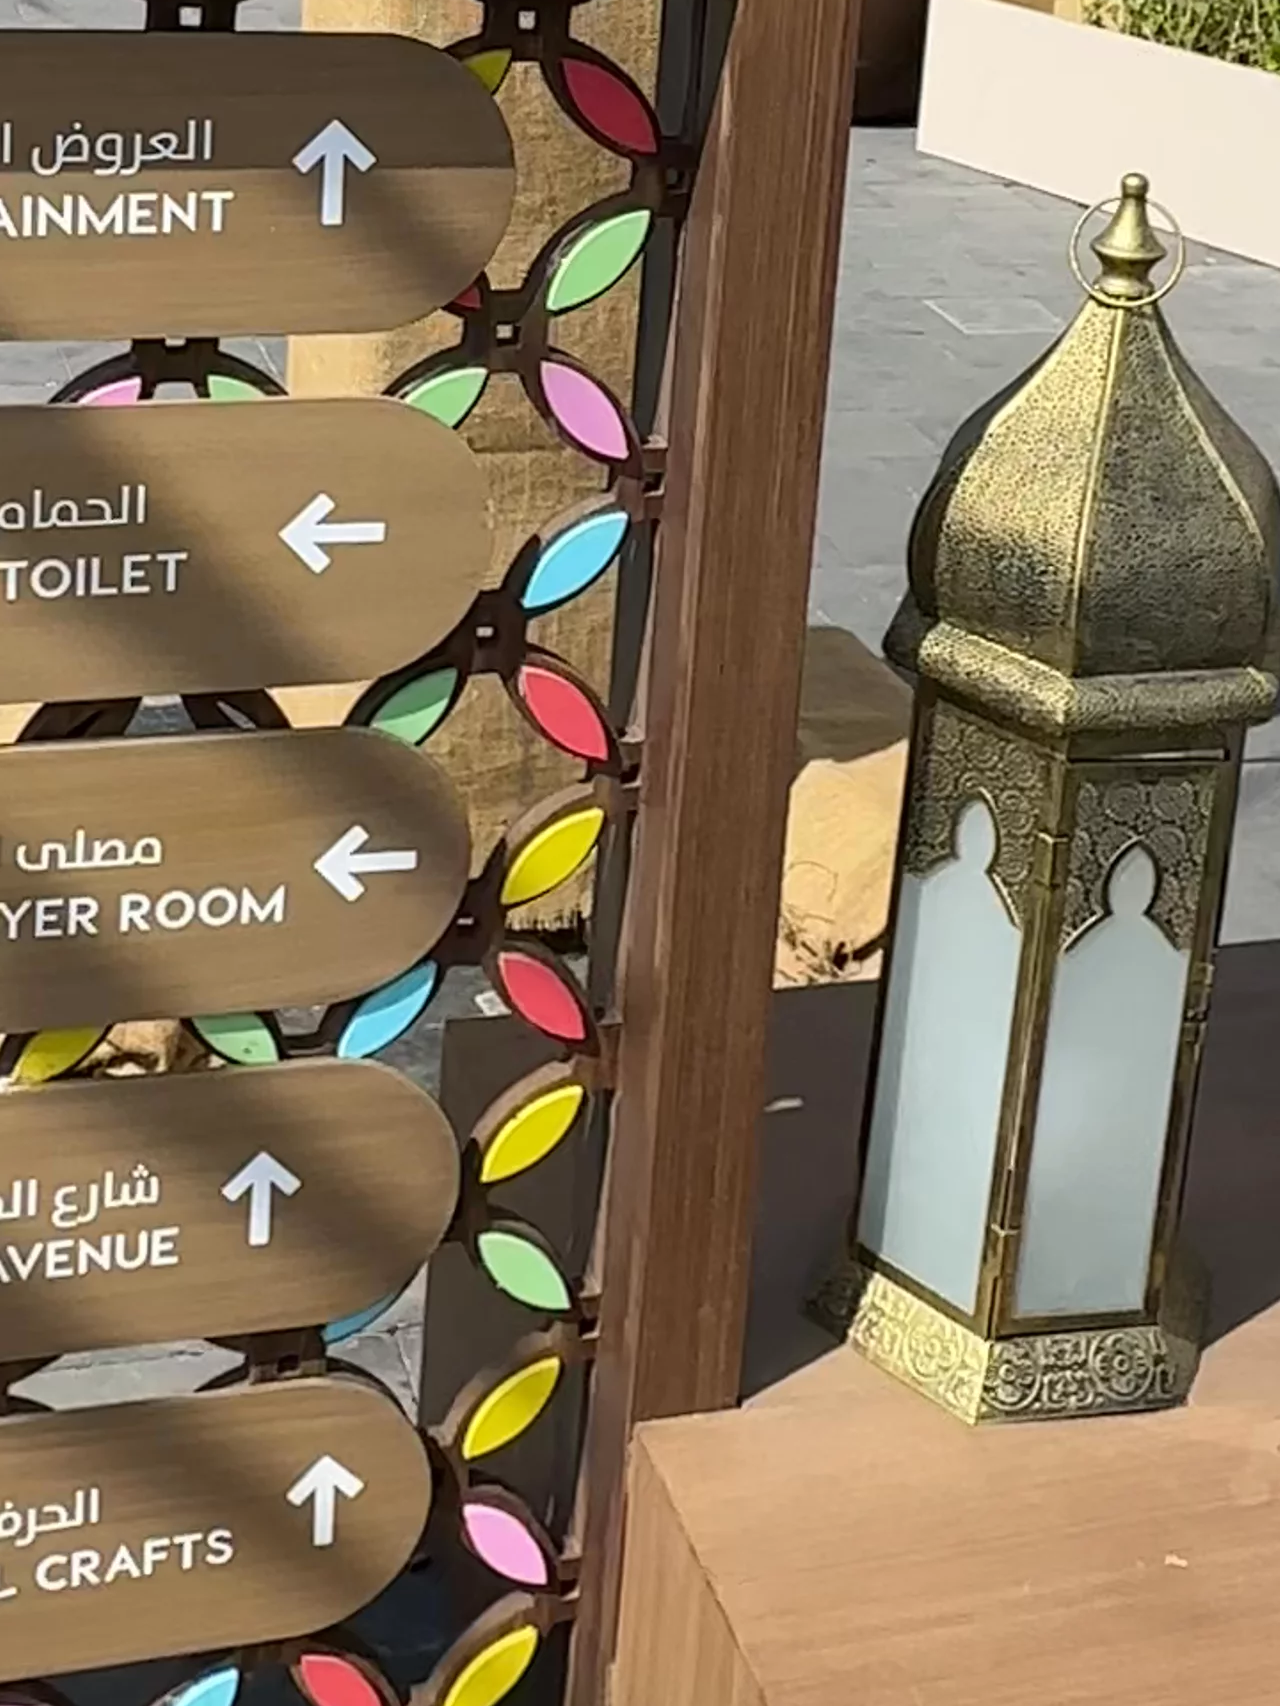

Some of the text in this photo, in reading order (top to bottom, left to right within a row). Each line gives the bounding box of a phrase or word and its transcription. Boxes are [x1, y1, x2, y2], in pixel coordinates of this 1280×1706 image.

[31, 119, 212, 177] العروض
[16, 829, 162, 871] مصلى
[119, 885, 285, 932] ROOM
[51, 1164, 159, 1228] شارع
[33, 1528, 233, 1591] CRAFTS
